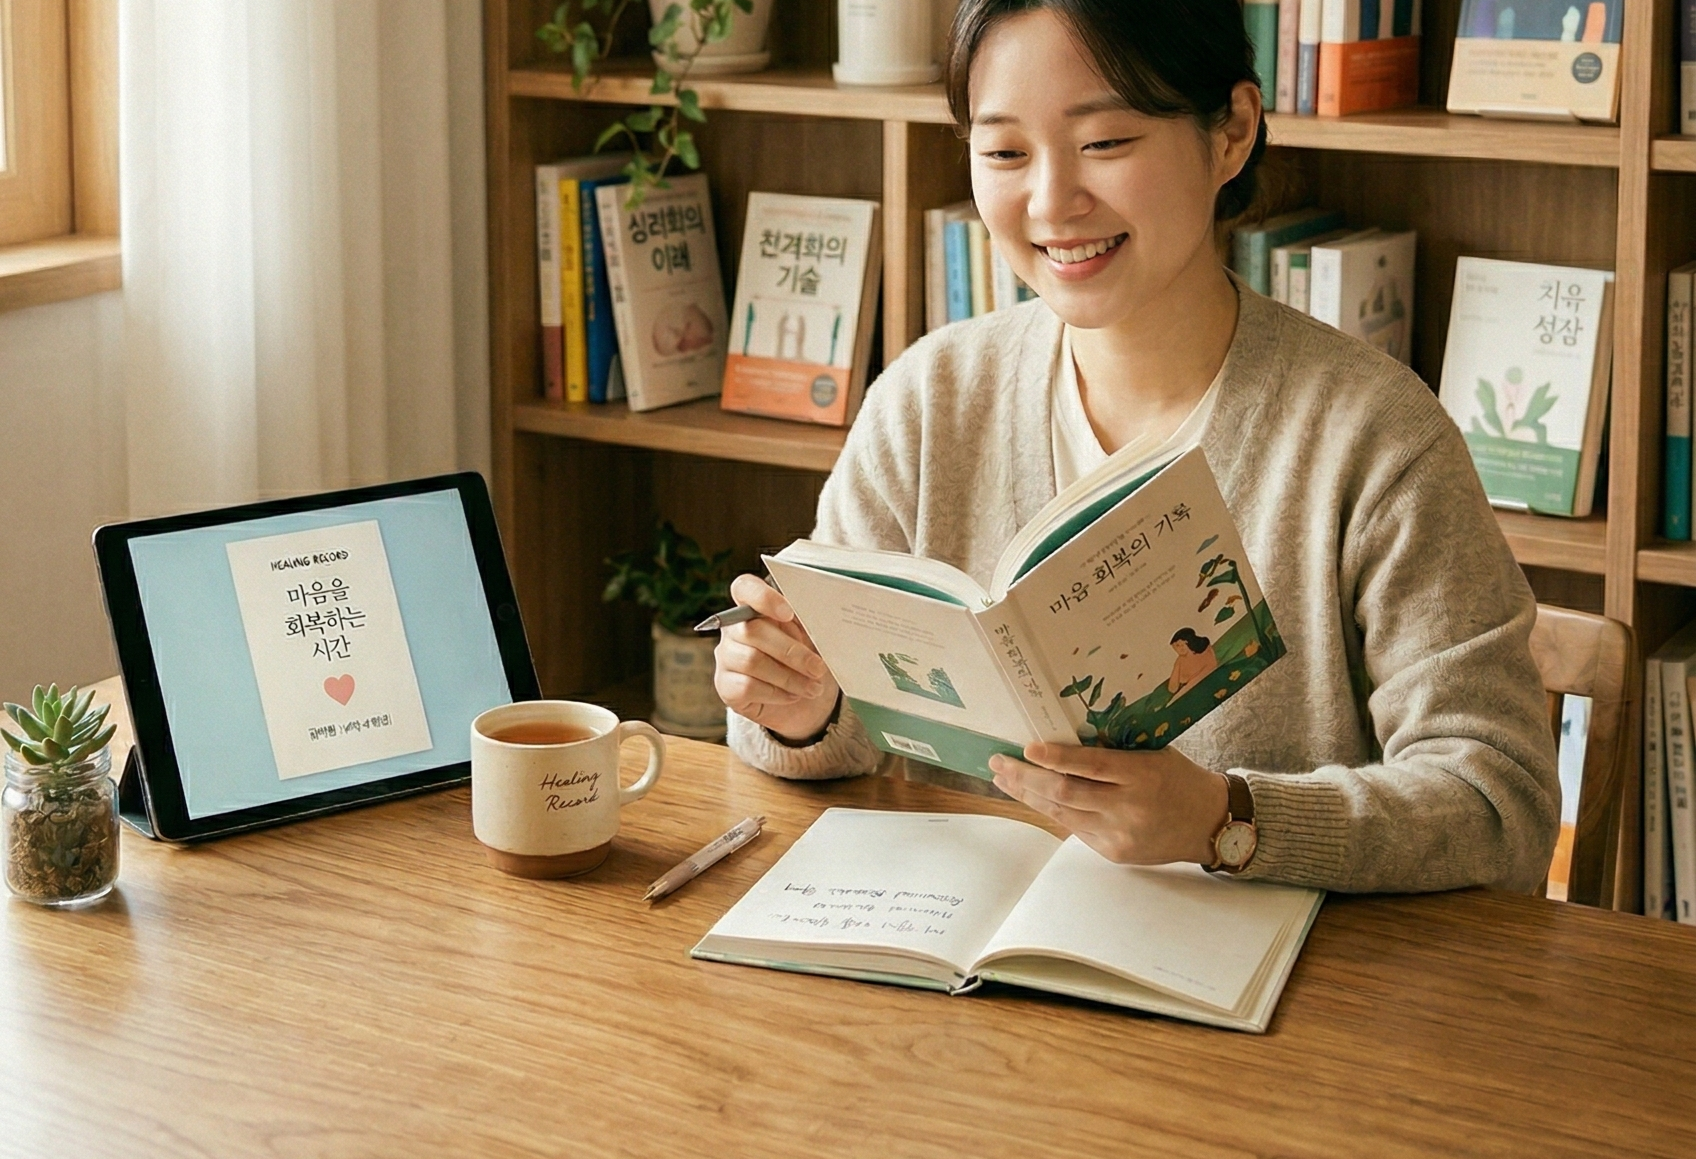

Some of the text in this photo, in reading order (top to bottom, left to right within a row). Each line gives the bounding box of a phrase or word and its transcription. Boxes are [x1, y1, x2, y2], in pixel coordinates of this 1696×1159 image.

[776, 264, 822, 296] 기술
[286, 577, 350, 607] 마음을
[1049, 582, 1090, 614] 마음
[284, 606, 367, 638] 회복하는
[312, 635, 352, 662] 시간
[538, 770, 602, 791] Healing
[545, 788, 600, 812] Record
